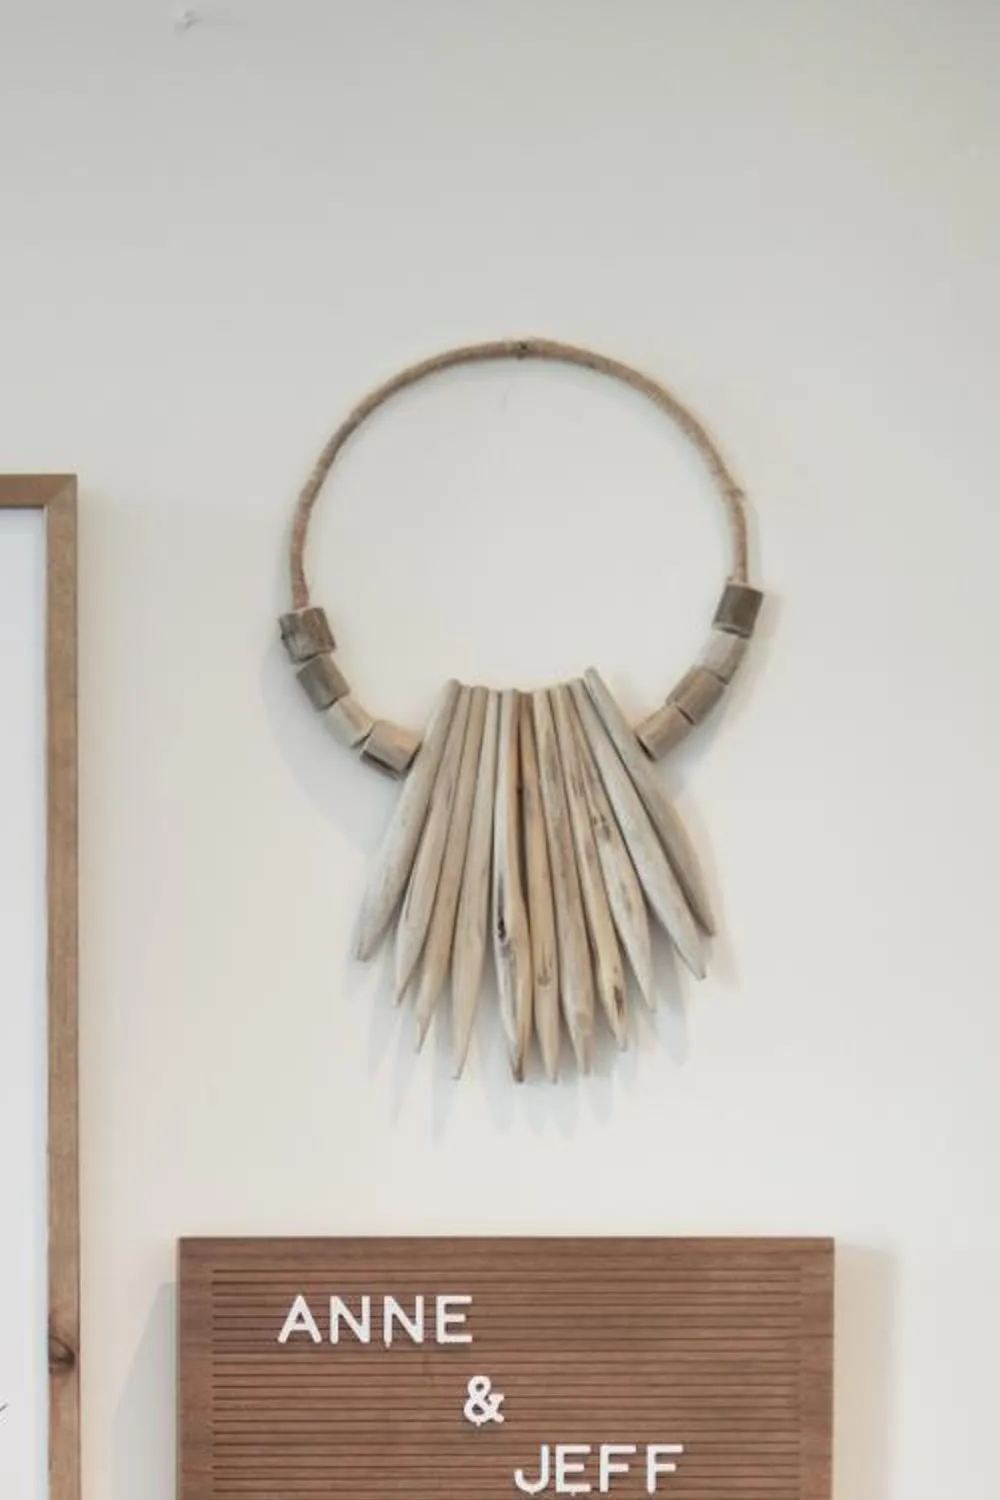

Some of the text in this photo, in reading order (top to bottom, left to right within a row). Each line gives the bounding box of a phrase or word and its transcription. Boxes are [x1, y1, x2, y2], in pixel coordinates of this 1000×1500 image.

[278, 1295, 473, 1346] ANNE
[463, 1375, 505, 1426] &
[514, 1444, 684, 1495] JEFF
